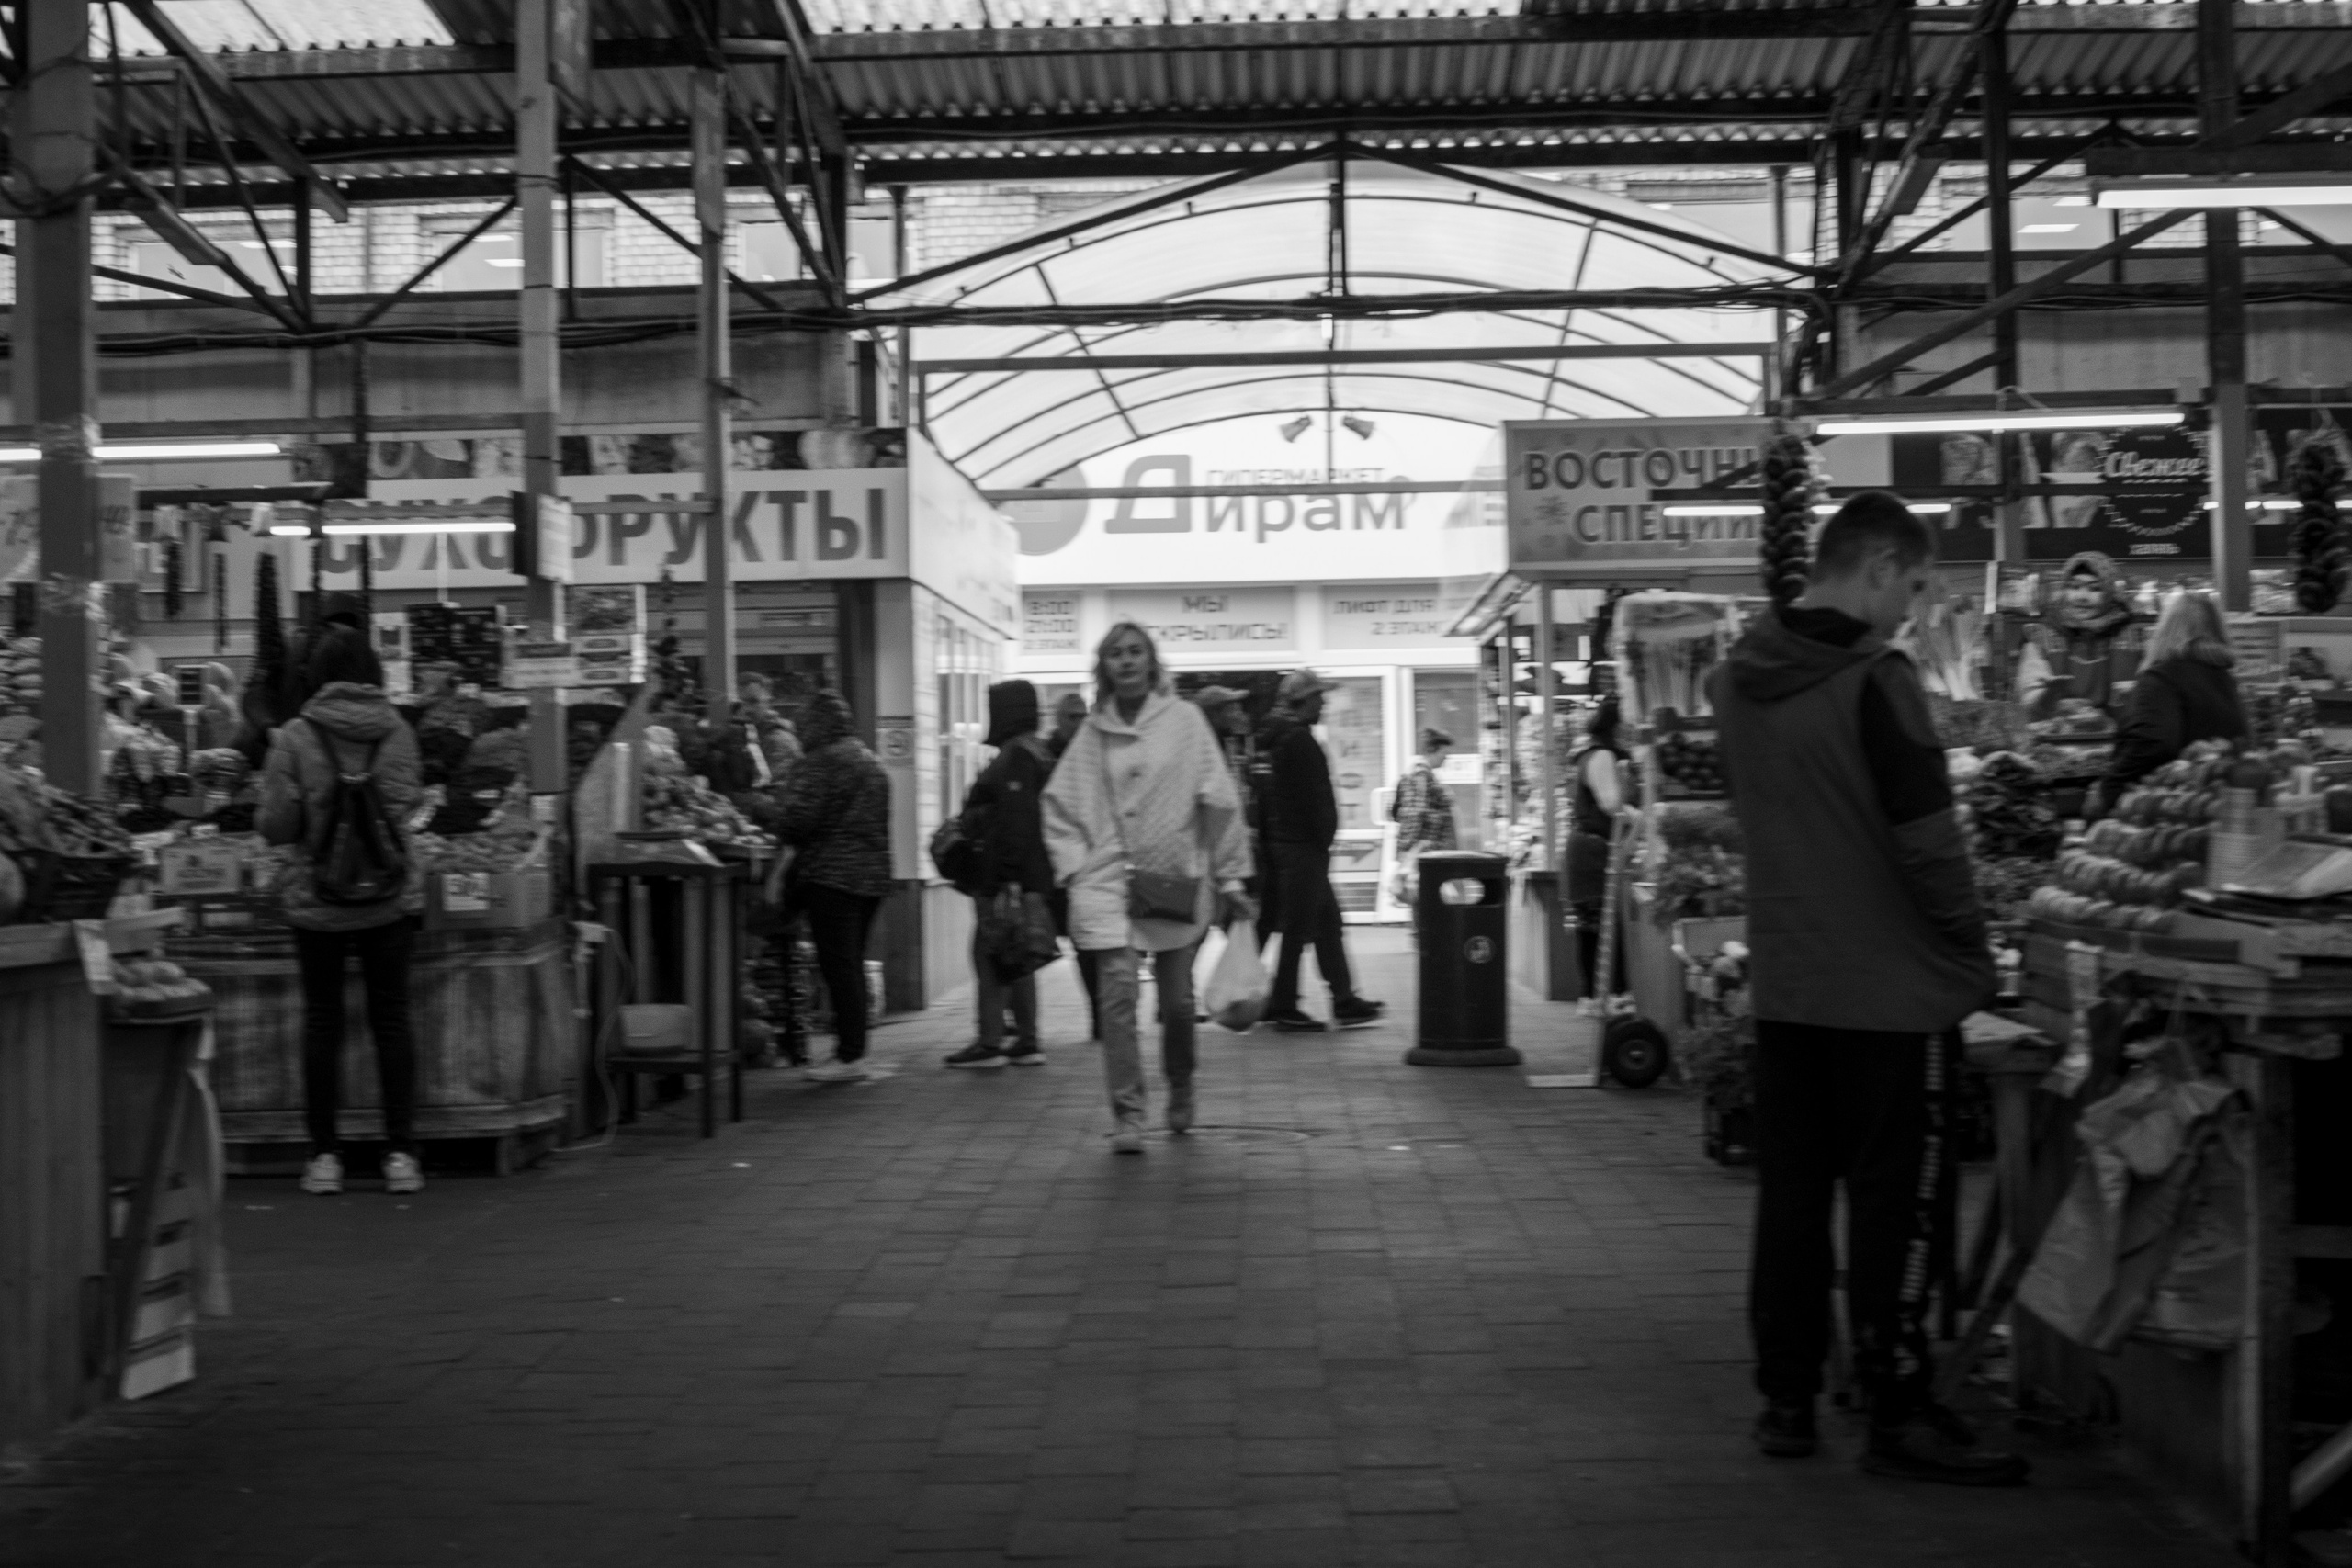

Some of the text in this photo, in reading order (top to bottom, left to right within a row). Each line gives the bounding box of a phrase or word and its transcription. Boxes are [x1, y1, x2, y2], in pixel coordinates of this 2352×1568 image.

[1525, 449, 1764, 489] ВОСТОЧН
[1105, 454, 1405, 544] Дирам
[1182, 596, 1229, 613] МЫ
[1145, 623, 1288, 641] ТКРЫЛИСЬ
